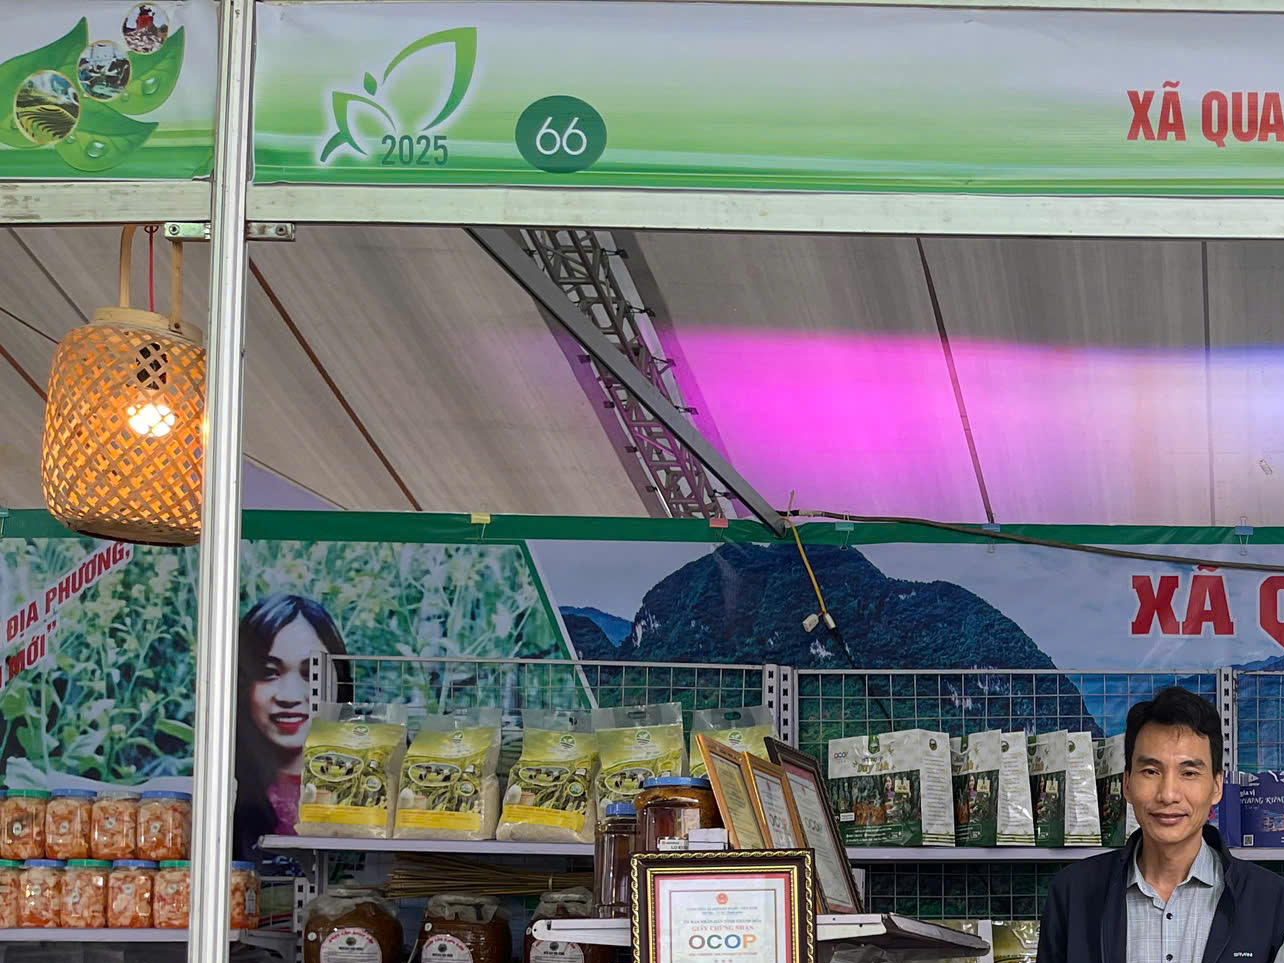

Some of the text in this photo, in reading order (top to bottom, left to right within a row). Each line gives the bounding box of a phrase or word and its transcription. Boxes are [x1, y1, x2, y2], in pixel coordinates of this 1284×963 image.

[1127, 80, 1187, 142] XÃ
[381, 134, 449, 166] 2025
[535, 117, 588, 156] 66
[1130, 565, 1235, 636] XÃ
[6, 600, 39, 643] ĐỊA
[689, 934, 757, 950] OCOP
